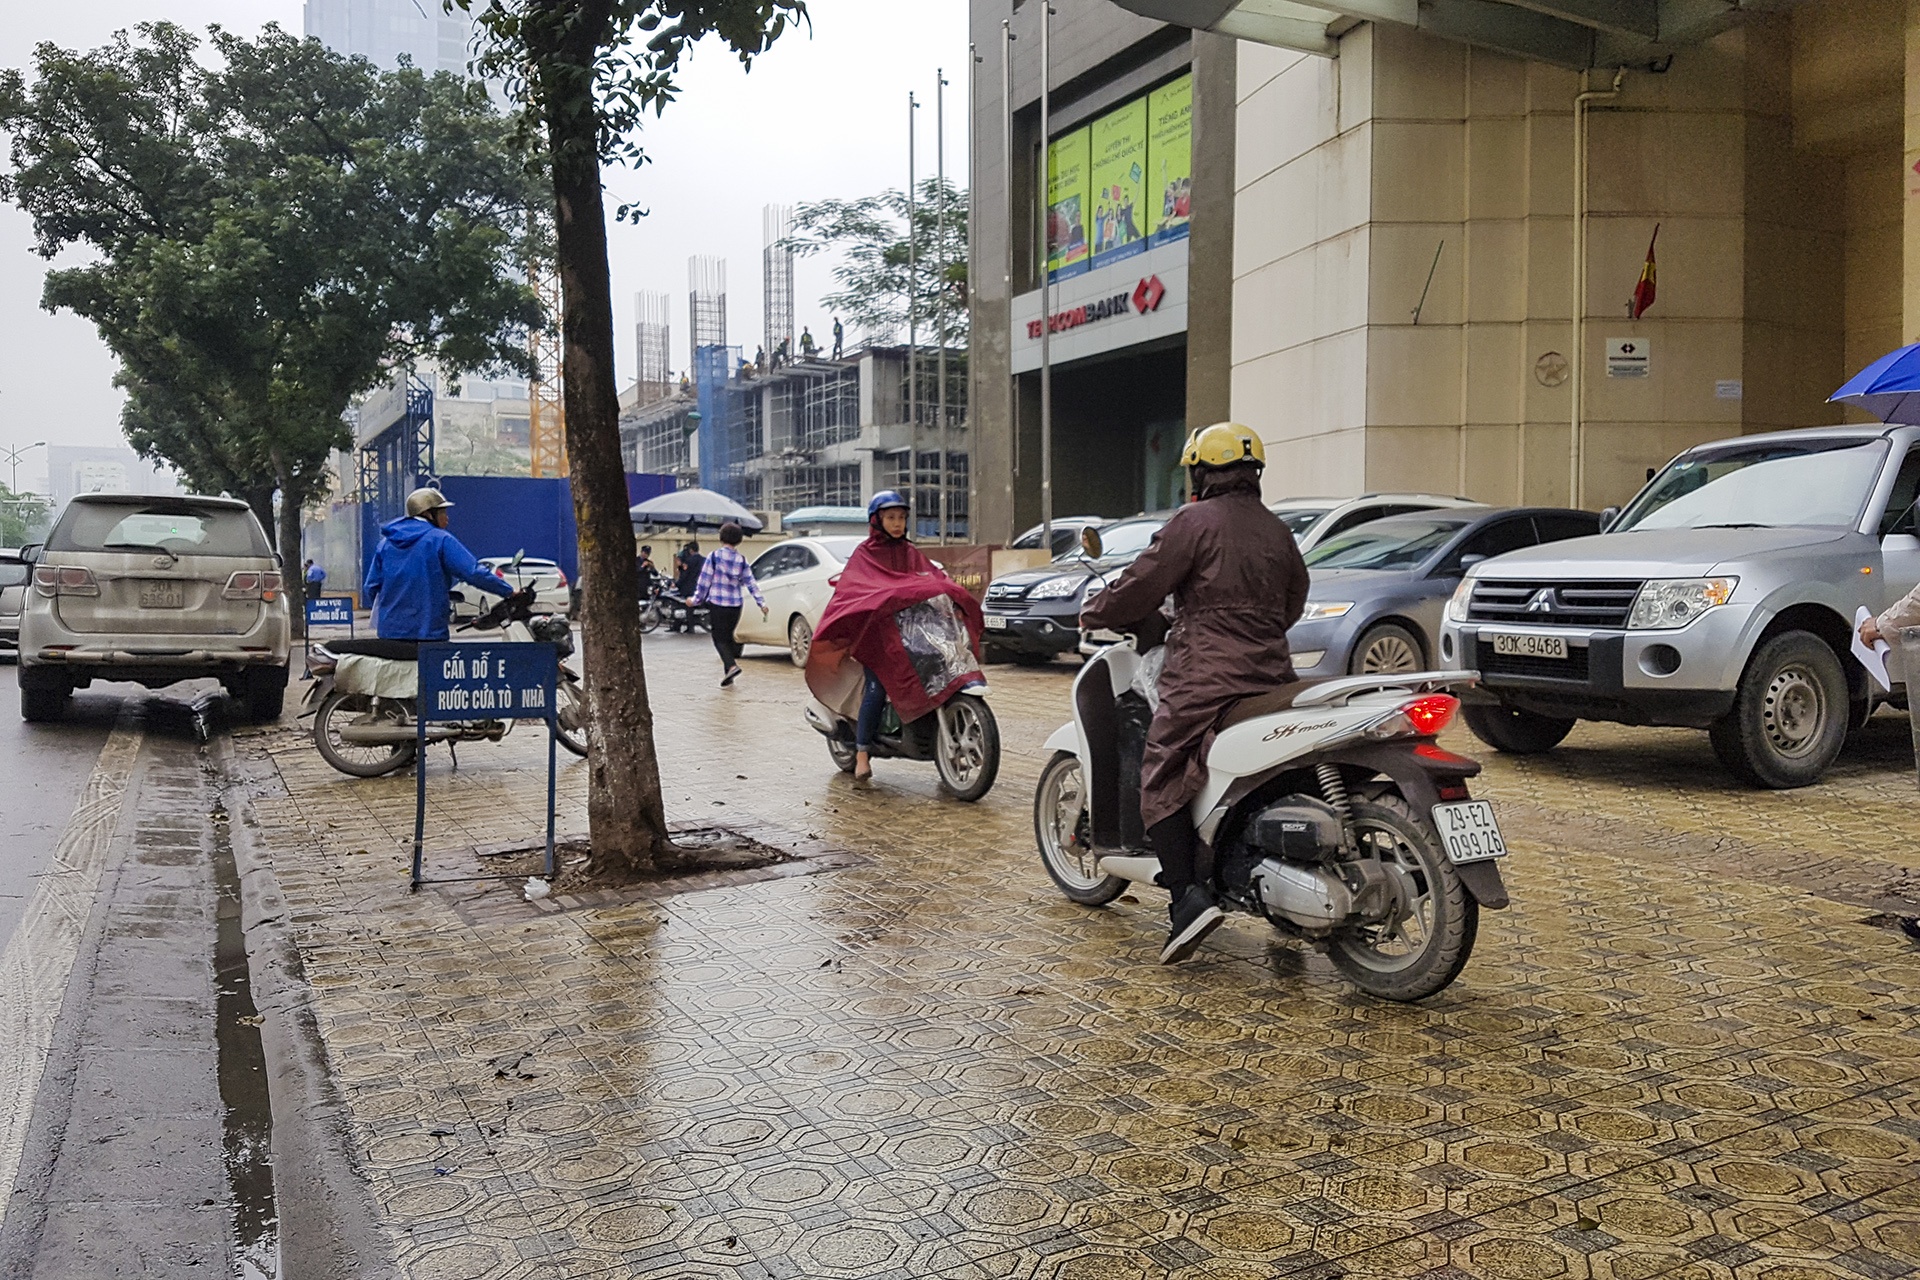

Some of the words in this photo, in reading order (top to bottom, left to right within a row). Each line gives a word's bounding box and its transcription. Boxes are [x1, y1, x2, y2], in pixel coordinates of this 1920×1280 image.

[1027, 292, 1130, 339] TEHCOMBANK
[472, 650, 491, 679] ĐỖ
[472, 682, 495, 710] CỬA
[521, 683, 545, 708] NHÀ
[1261, 721, 1304, 742] SH
[1297, 719, 1337, 734] mode
[1445, 804, 1490, 832] 29-E2
[1449, 829, 1503, 859] 099.26
